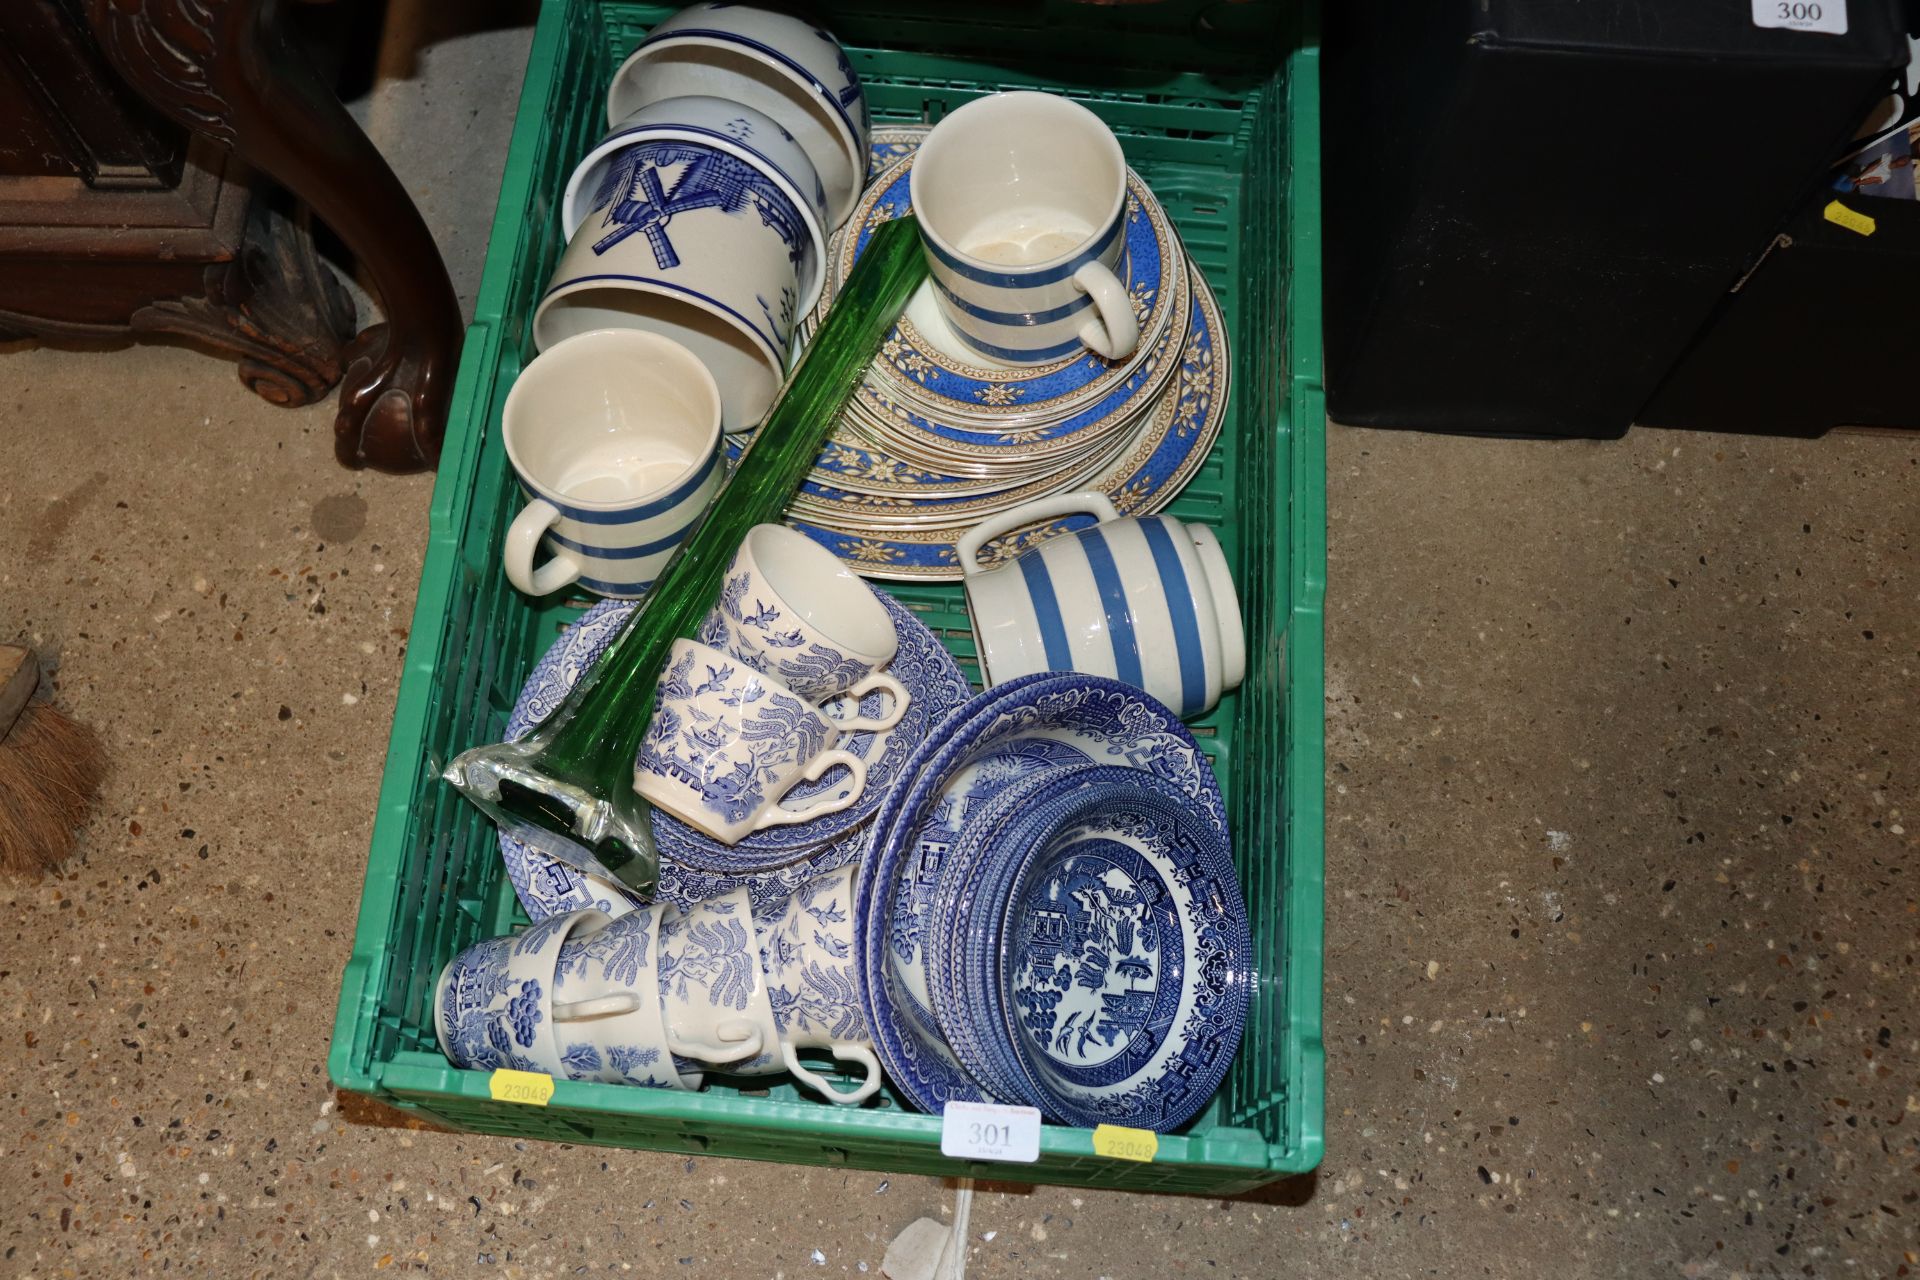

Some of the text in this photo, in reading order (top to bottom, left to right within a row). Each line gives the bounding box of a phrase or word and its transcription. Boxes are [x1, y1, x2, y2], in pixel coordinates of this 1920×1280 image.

[1777, 2, 1822, 21] 300
[503, 1083, 548, 1101] 23048
[968, 1122, 1011, 1147] 301
[1107, 1139, 1152, 1158] 23048
